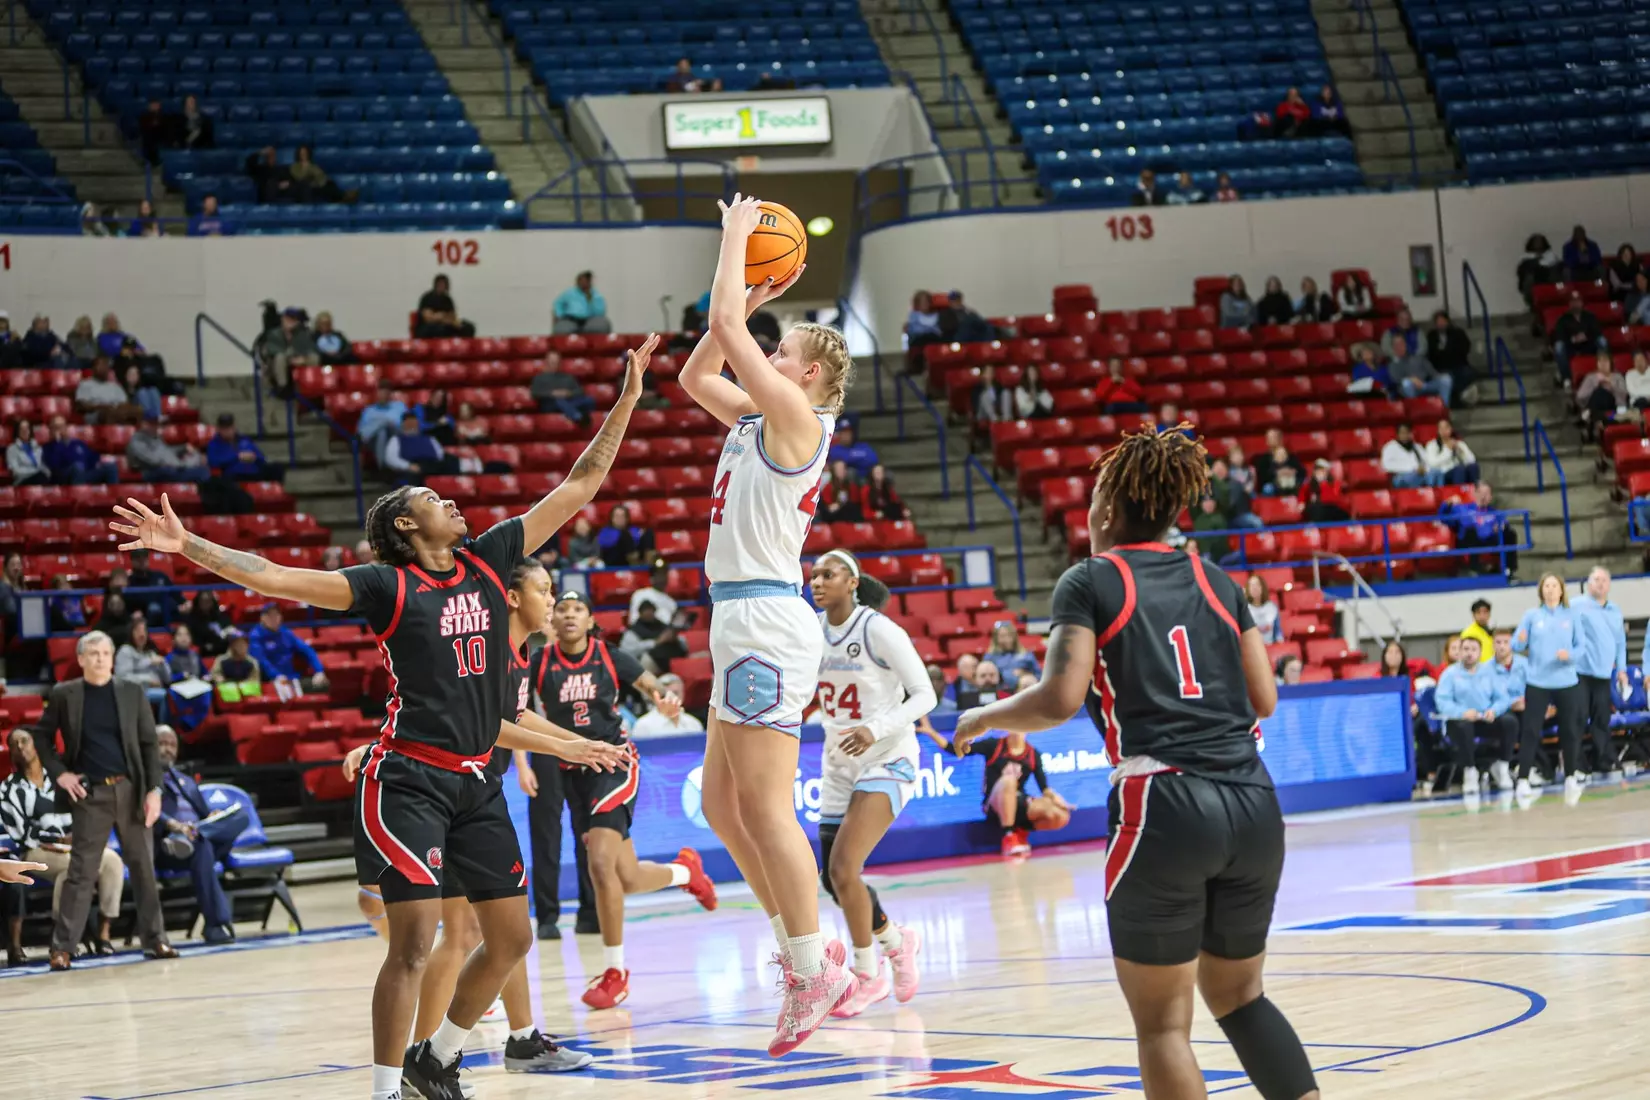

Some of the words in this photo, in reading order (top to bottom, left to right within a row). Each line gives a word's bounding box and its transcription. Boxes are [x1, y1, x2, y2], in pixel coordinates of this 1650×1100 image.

[675, 112, 734, 137] Super
[737, 106, 757, 139] 1
[757, 109, 818, 129] Foods
[1105, 214, 1154, 241] 103
[432, 239, 480, 266] 102
[442, 591, 483, 616] JAX
[440, 609, 491, 637] STATE
[453, 635, 487, 678] 10
[1167, 625, 1203, 698] 1
[559, 683, 598, 703] STATE
[562, 673, 593, 690] JAX
[573, 701, 592, 727] 2
[818, 681, 862, 720] 24
